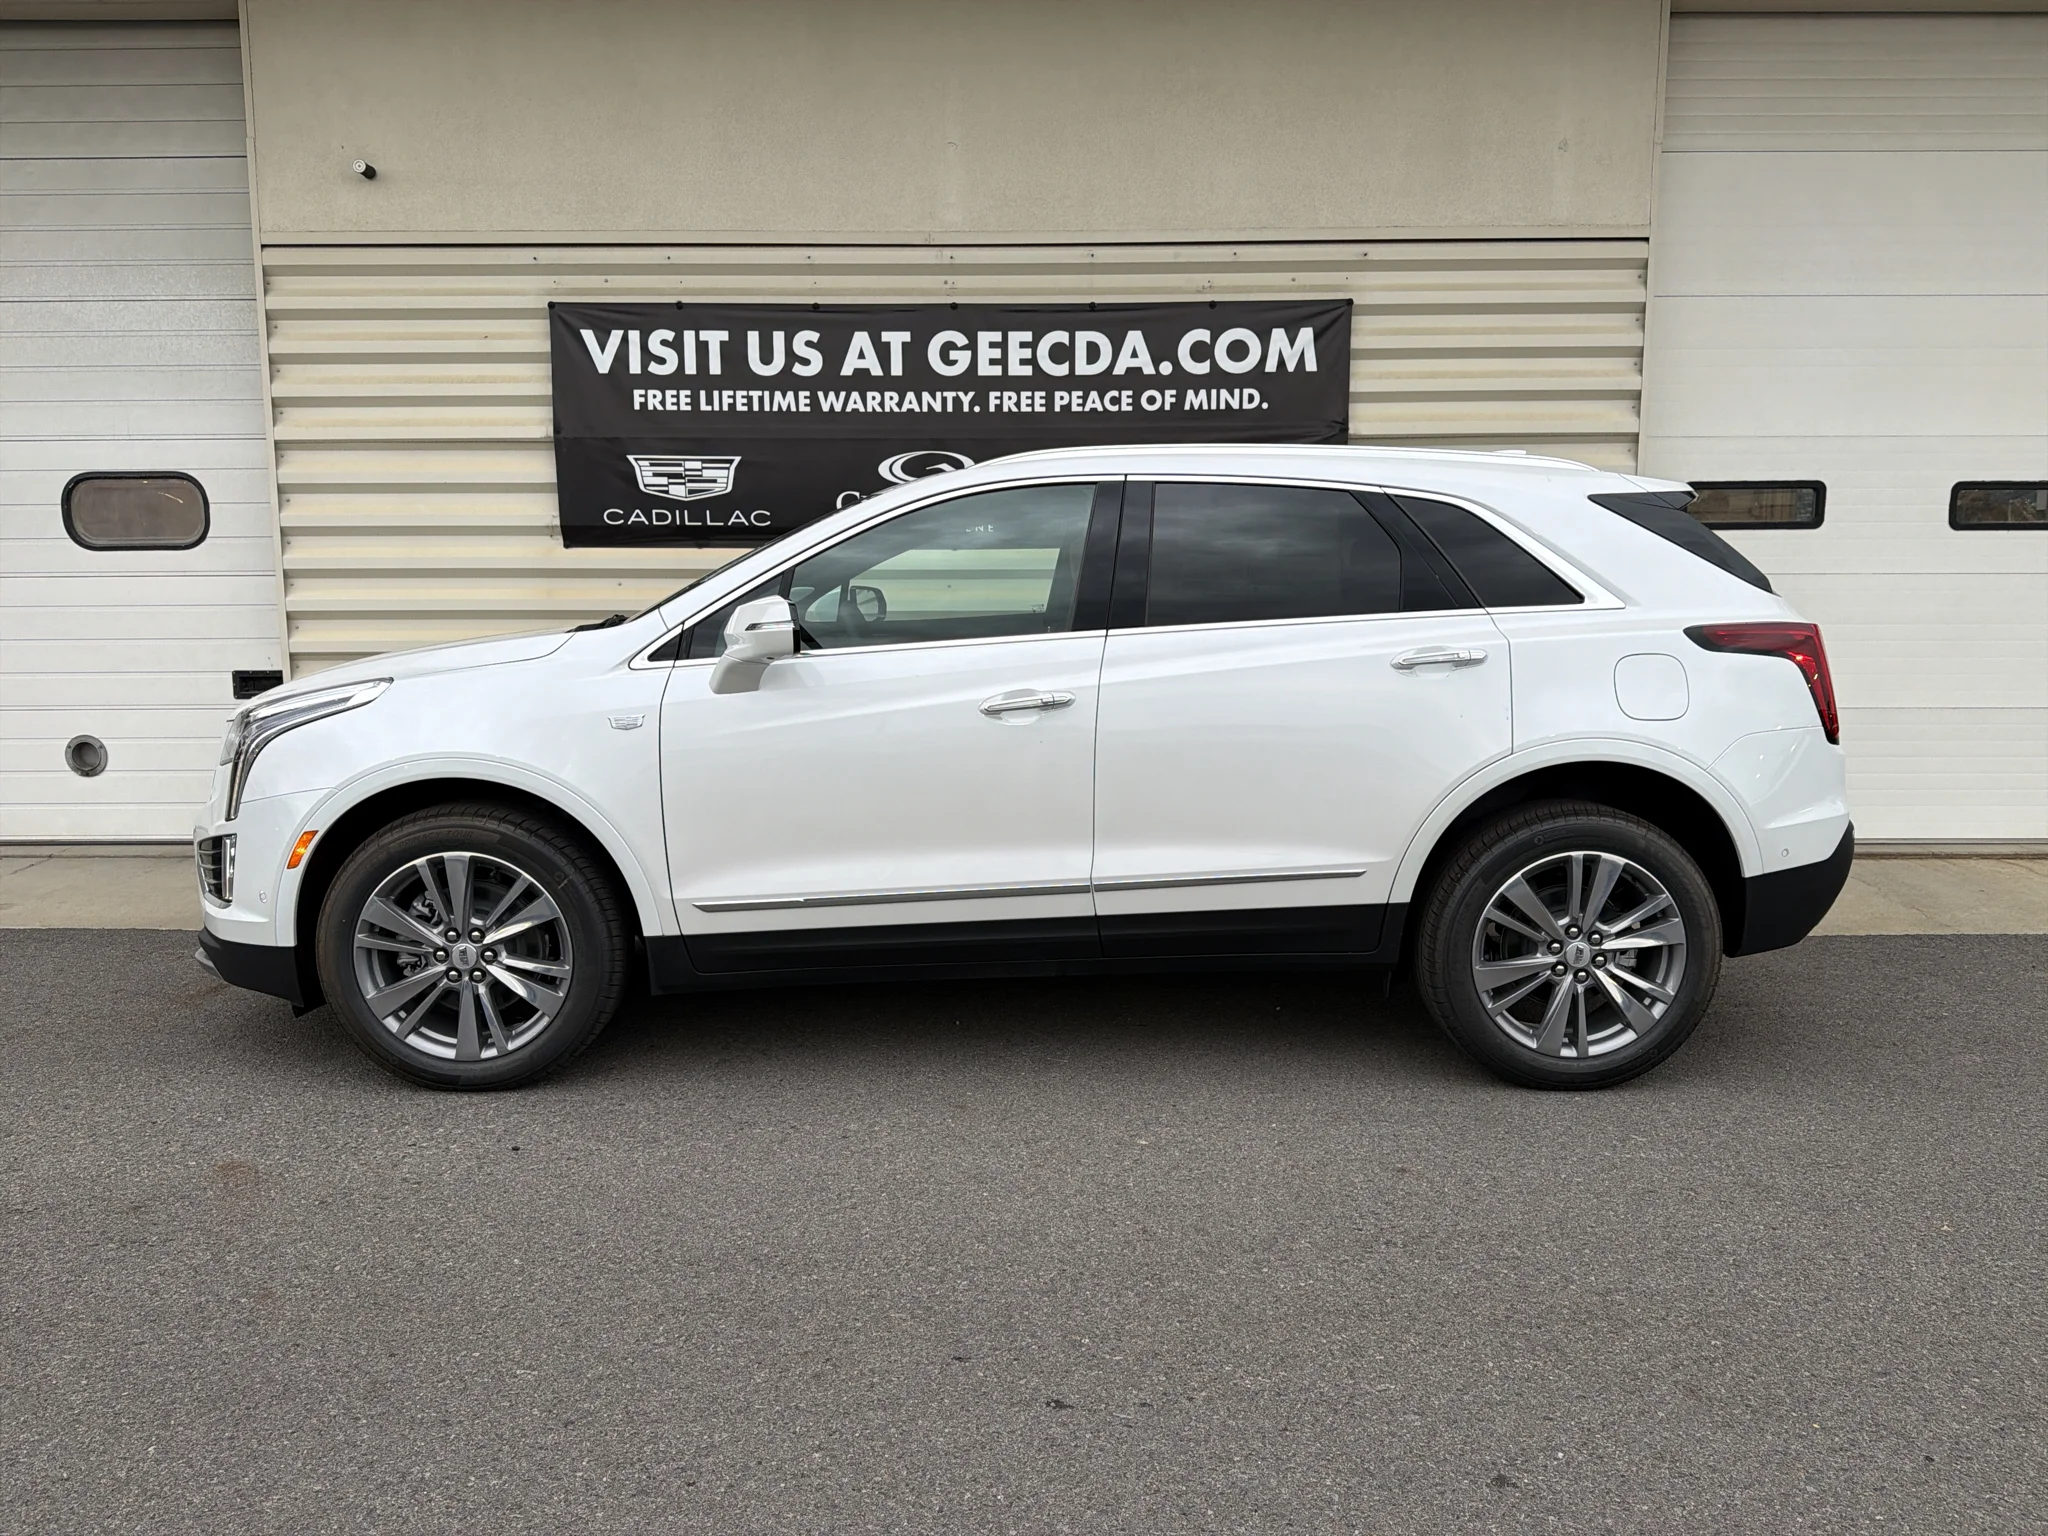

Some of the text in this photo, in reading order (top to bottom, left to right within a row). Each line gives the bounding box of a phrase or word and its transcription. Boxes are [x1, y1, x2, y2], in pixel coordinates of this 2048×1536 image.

[580, 327, 1317, 376] VISIT US AT GEECDA.COM
[633, 388, 1269, 412] FREE LIFETIME WARRANTY. FREE PEACE OF MIND.
[603, 508, 771, 526] CADILLAC
[447, 829, 475, 838] TOUR
